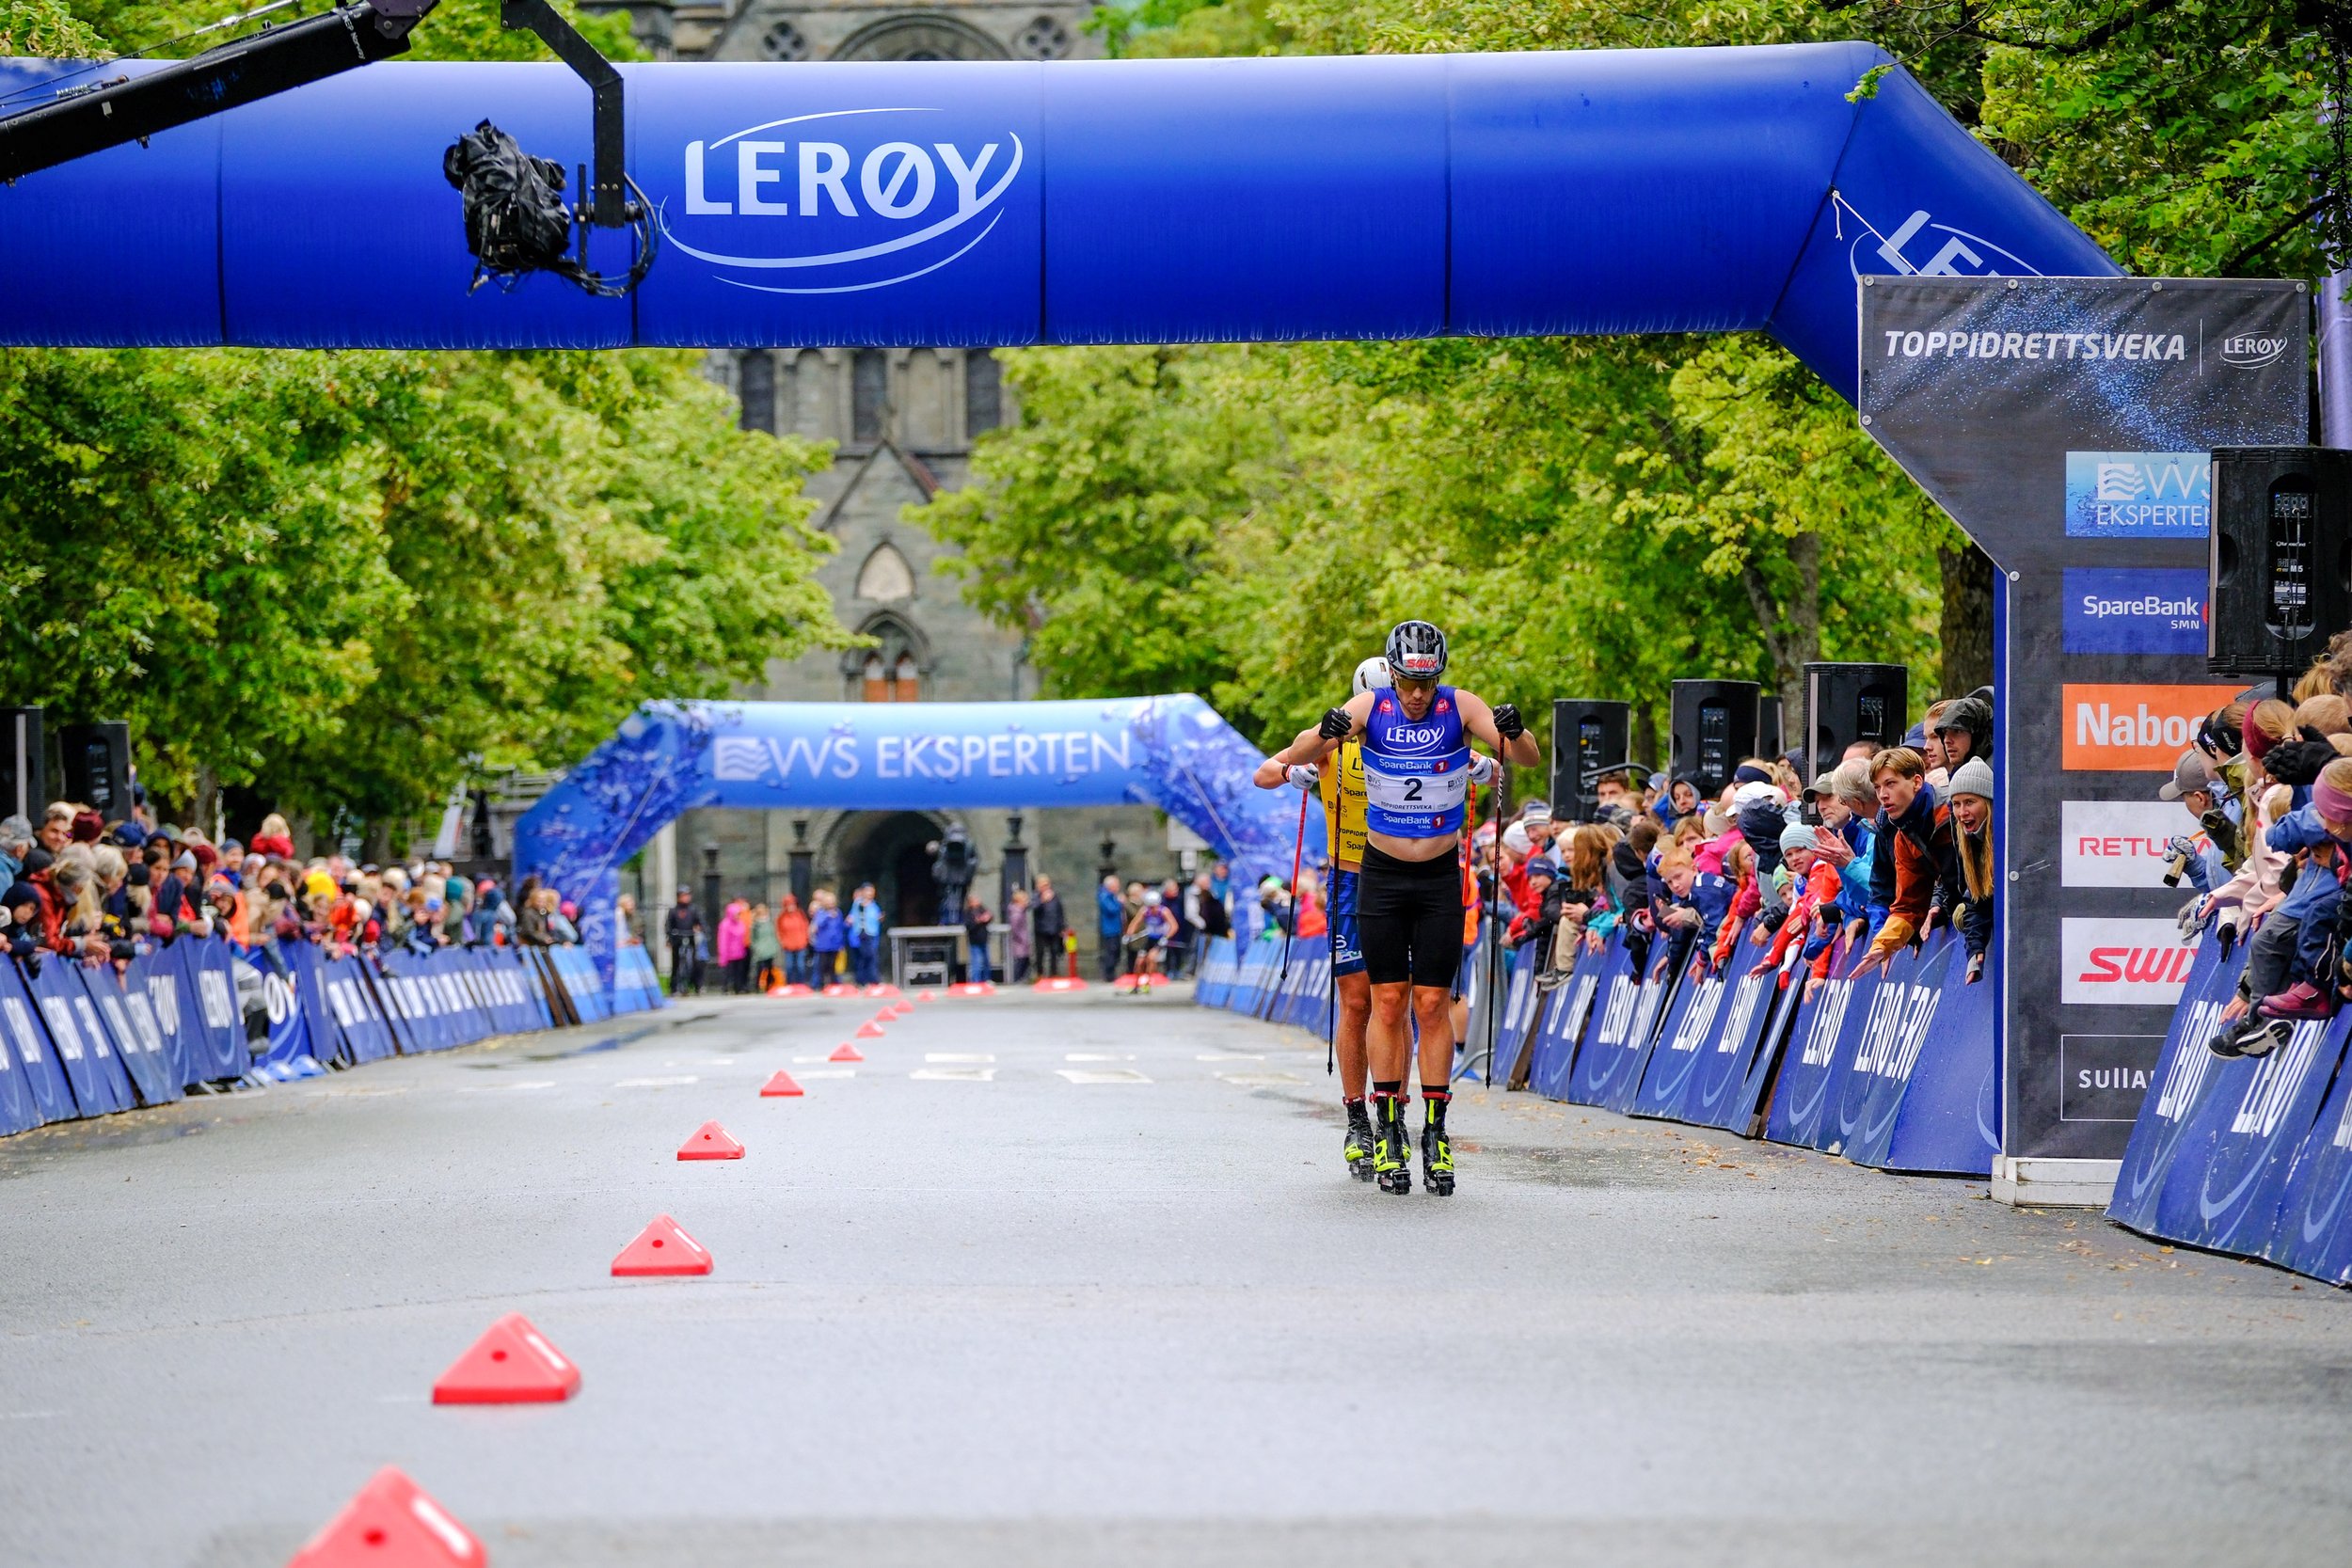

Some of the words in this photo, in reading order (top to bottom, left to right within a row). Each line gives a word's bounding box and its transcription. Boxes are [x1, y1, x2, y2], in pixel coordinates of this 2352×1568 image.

[685, 140, 999, 219] LERØY
[1884, 331, 2185, 360] TOPPIDRETTSVEKA
[2224, 339, 2283, 355] LERØY
[2083, 595, 2200, 618] SpareBank
[2170, 620, 2200, 629] SMN
[1386, 727, 1441, 743] LERØY
[769, 736, 860, 780] VVS
[876, 730, 1129, 780] EKSPERTEN
[1378, 758, 1433, 771] SpareBank
[1404, 778, 1422, 801] 2
[1383, 813, 1431, 825] SpareBank
